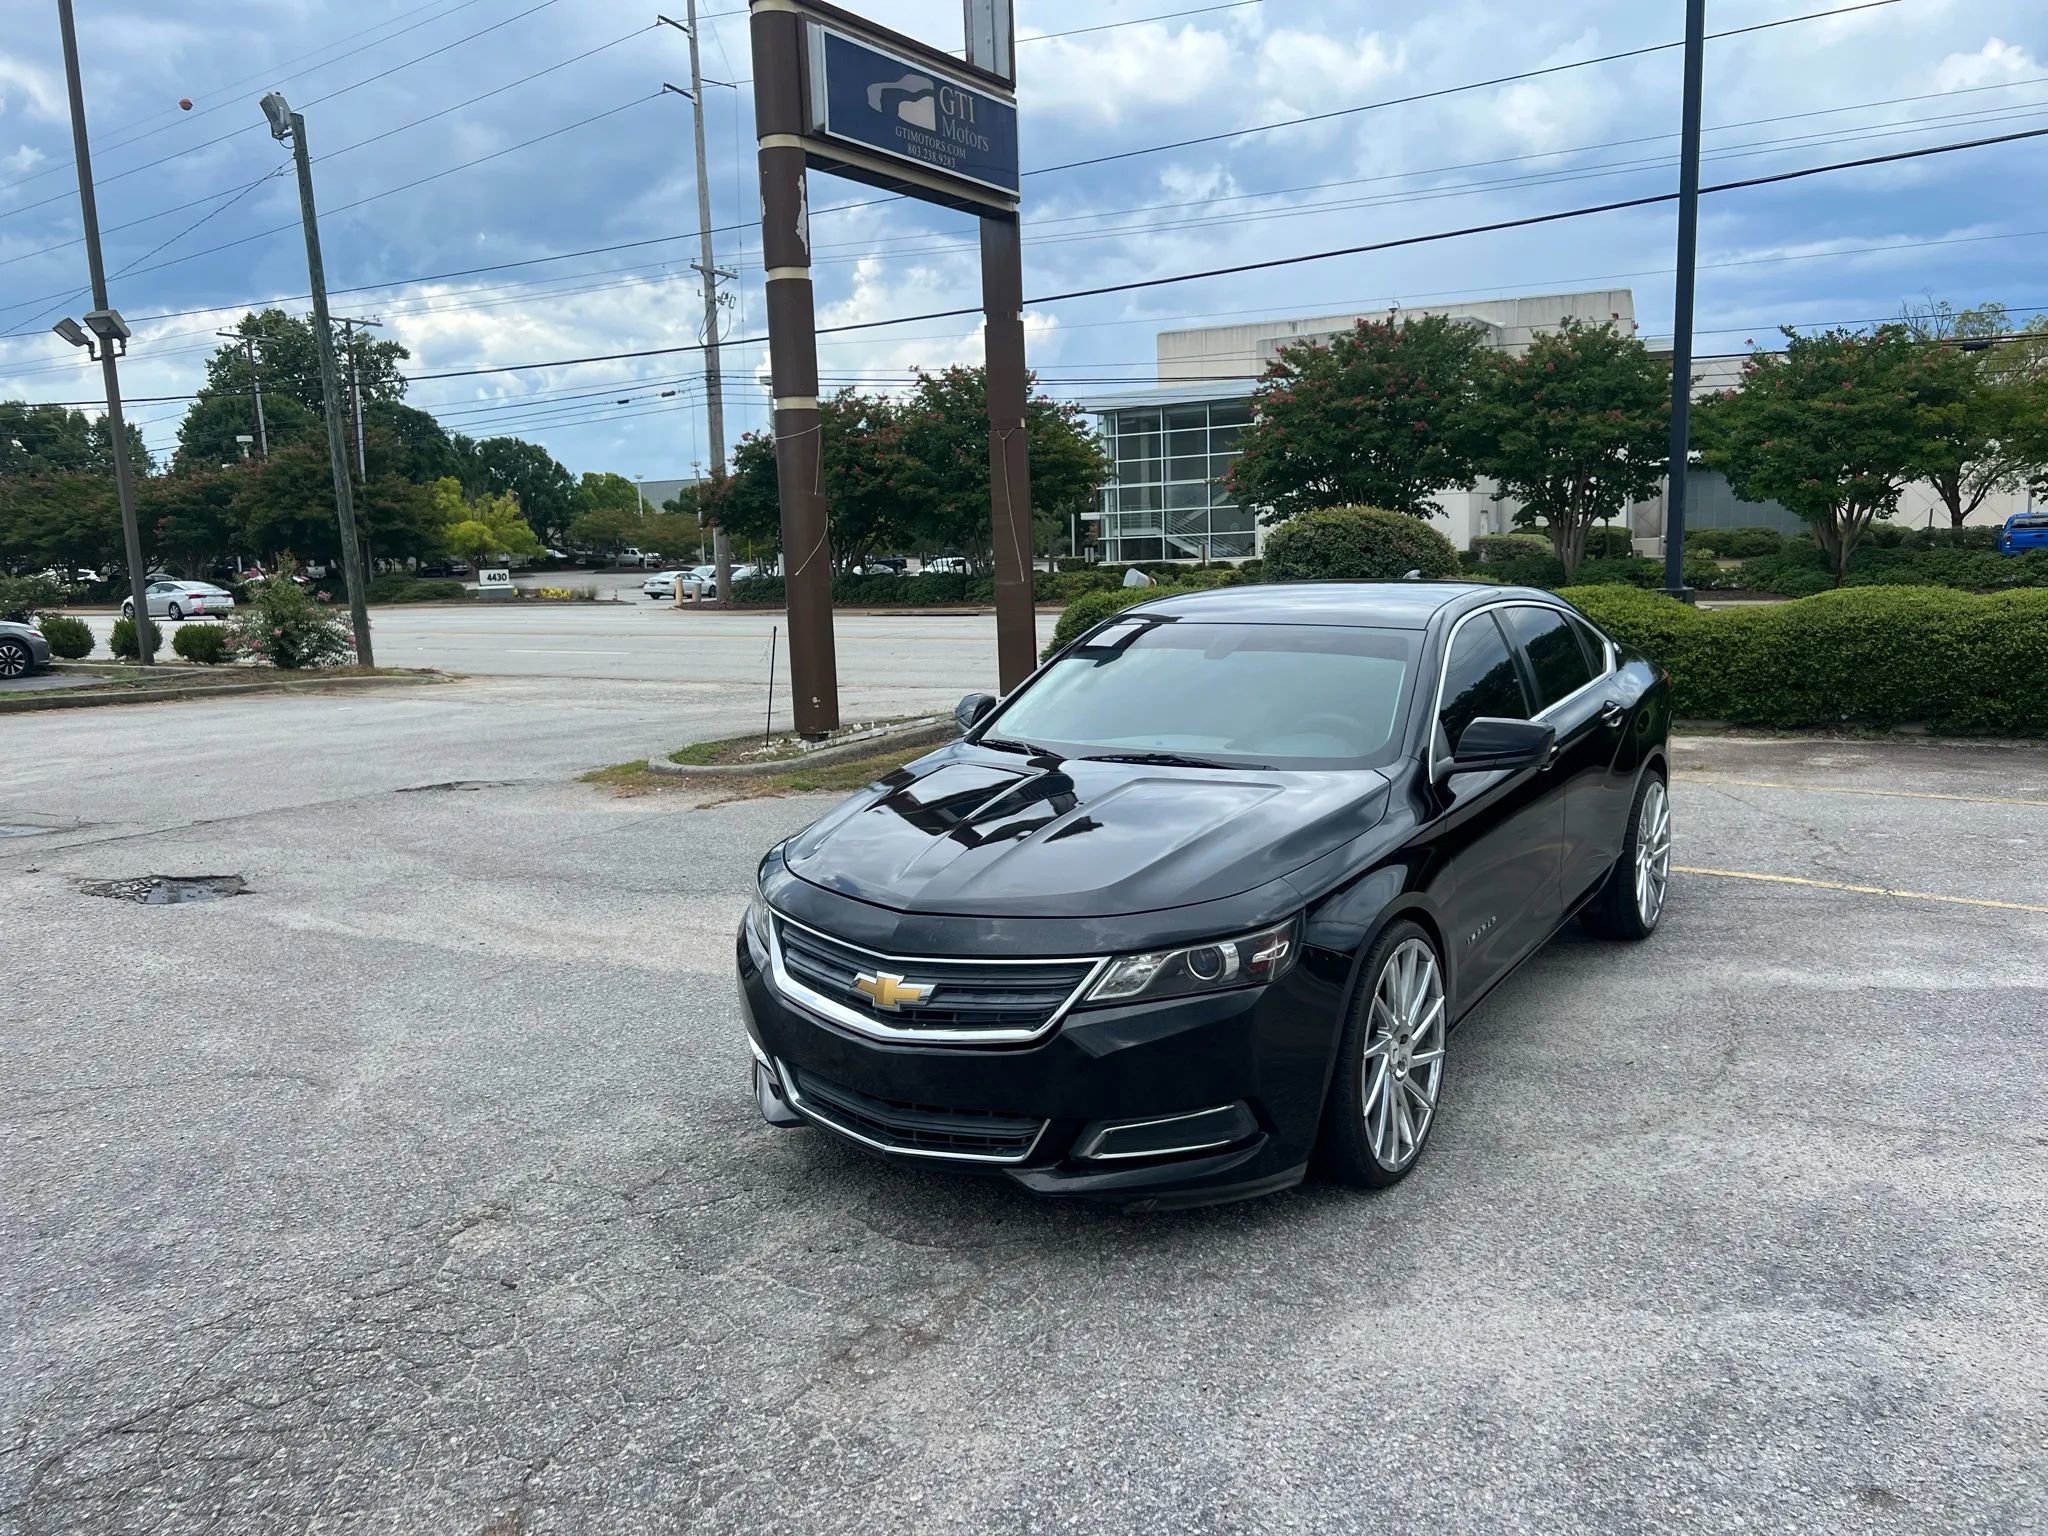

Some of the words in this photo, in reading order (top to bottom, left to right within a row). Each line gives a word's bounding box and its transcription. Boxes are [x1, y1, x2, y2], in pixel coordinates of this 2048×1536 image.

[940, 87, 975, 123] GTI
[896, 126, 965, 158] GTIMOTORS.COM
[942, 116, 988, 151] Motors
[487, 573, 507, 581] 4430
